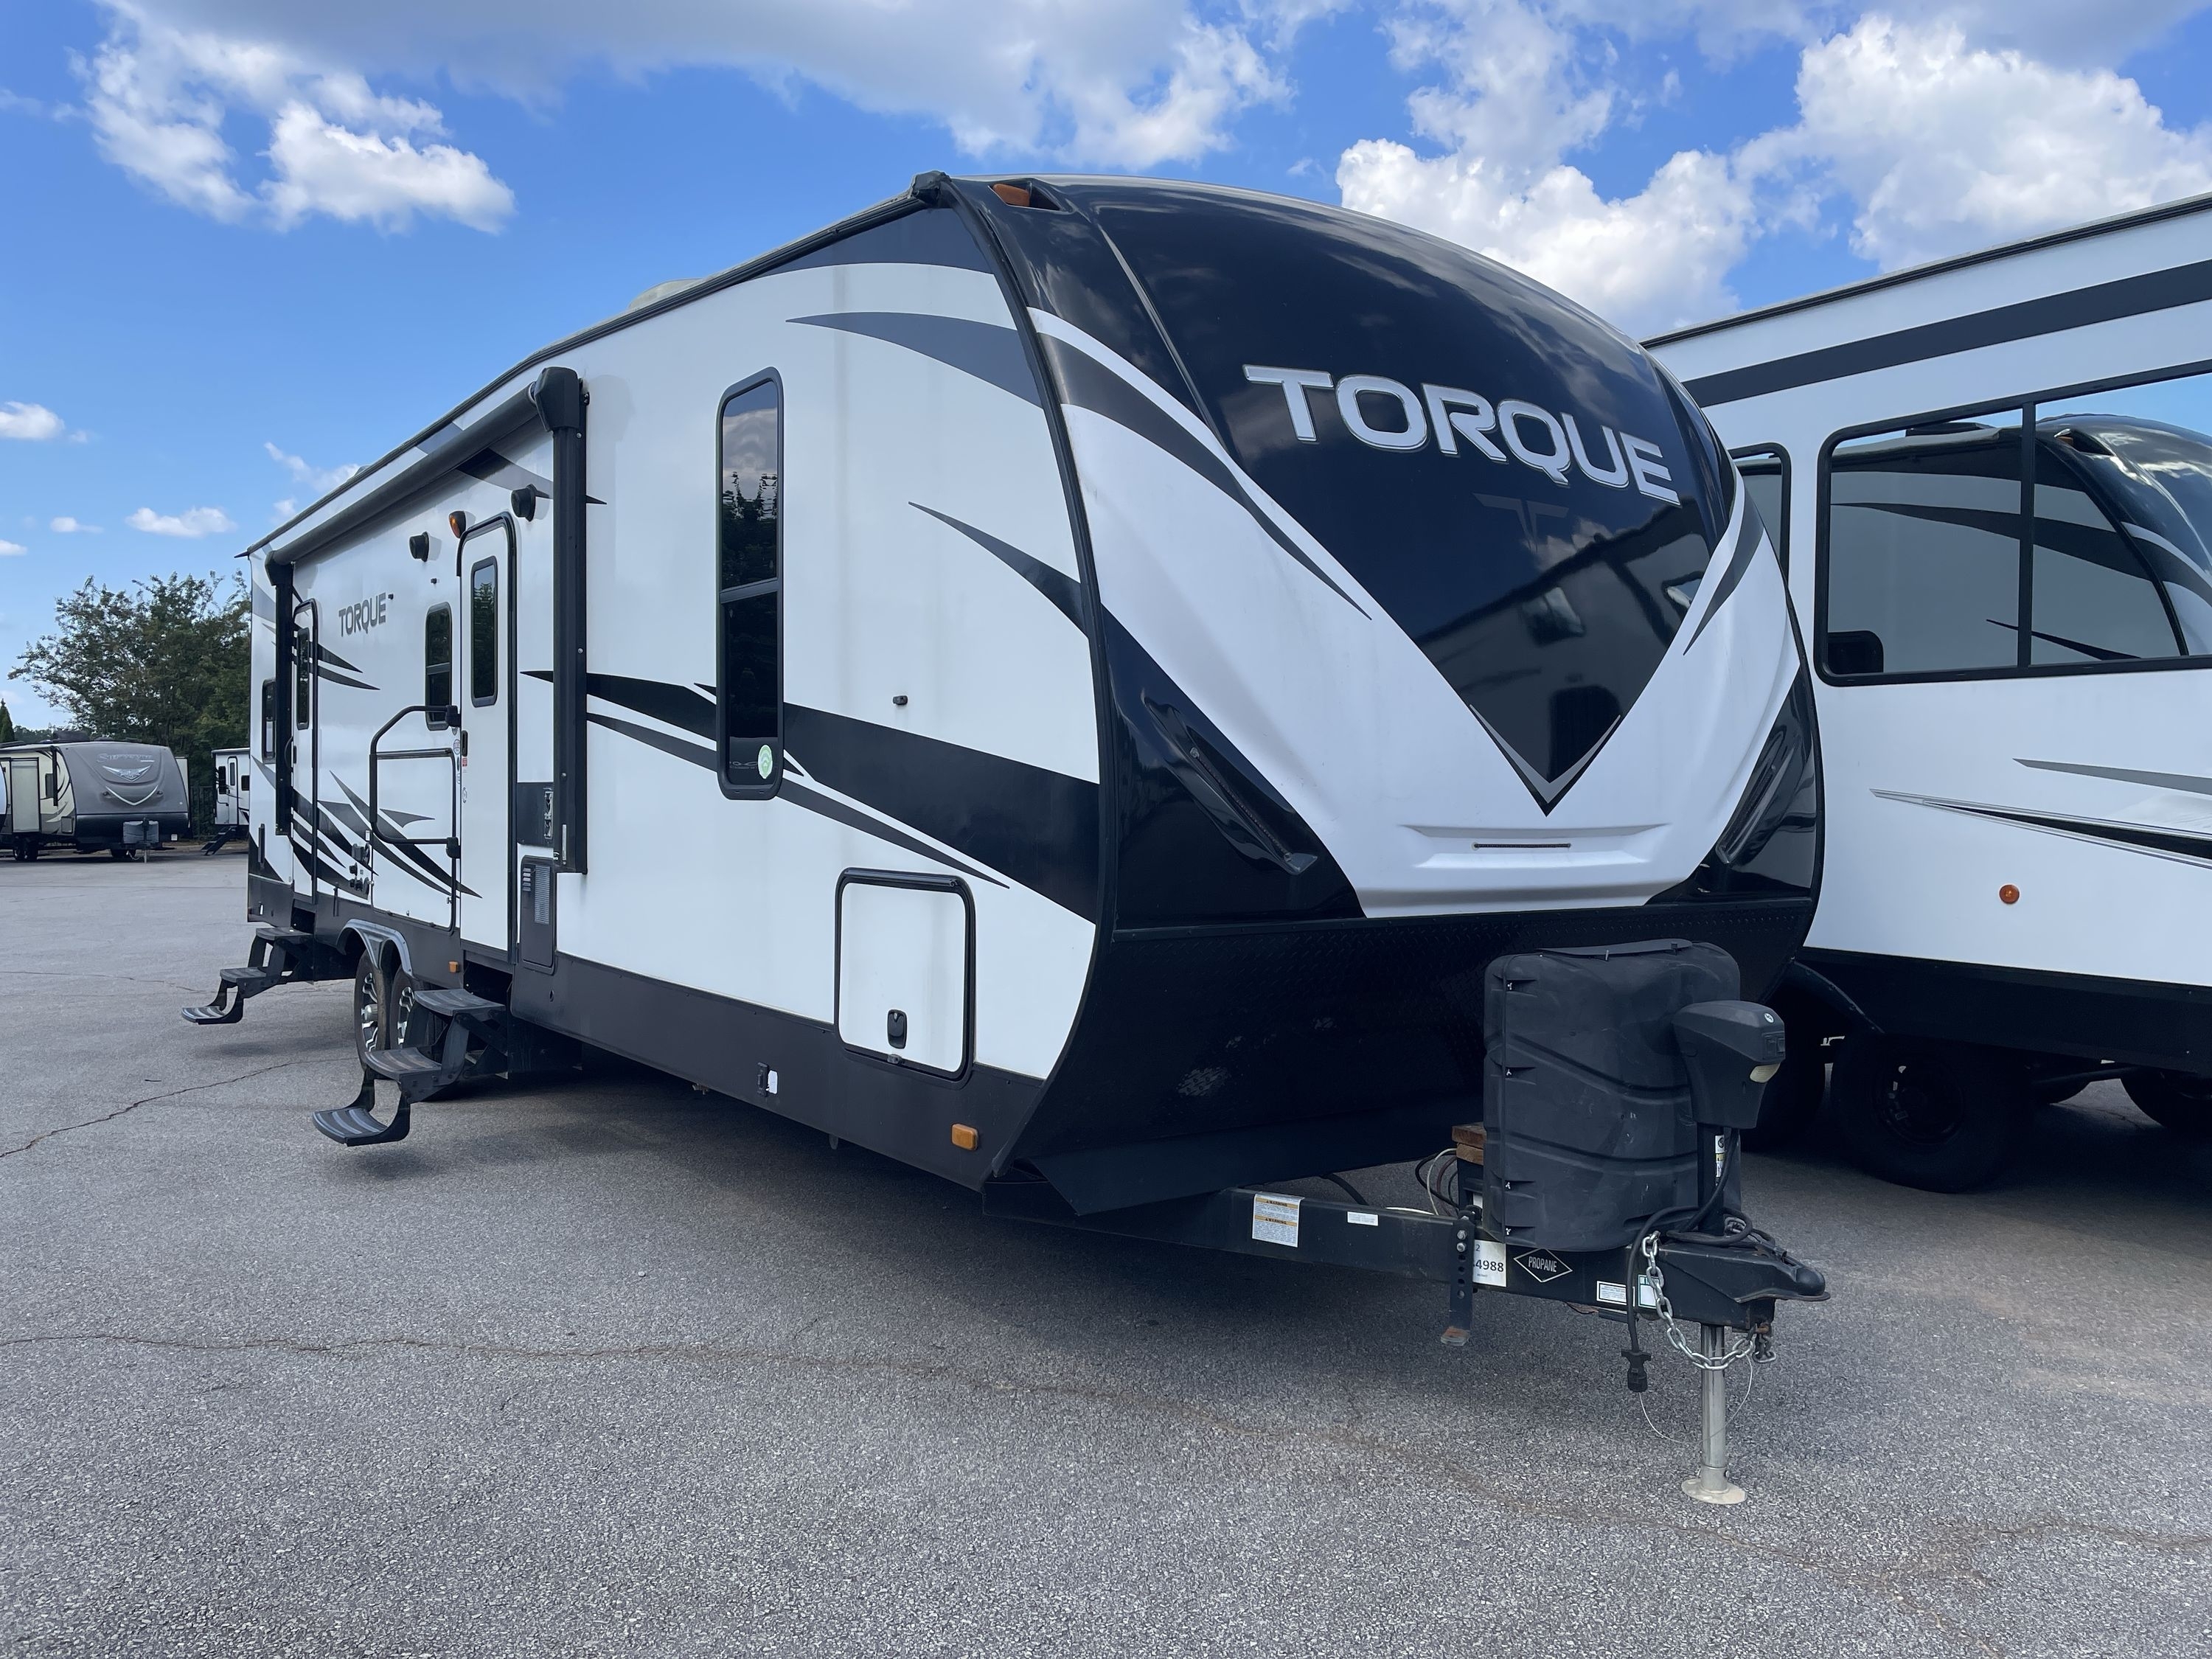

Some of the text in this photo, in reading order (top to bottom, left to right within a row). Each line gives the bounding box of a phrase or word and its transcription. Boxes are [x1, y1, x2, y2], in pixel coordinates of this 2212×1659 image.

[1242, 364, 1682, 507] TORQUE
[338, 592, 386, 637] TORQUE
[1473, 1259, 1504, 1273] 4988
[1528, 1256, 1557, 1273] PROPANE
